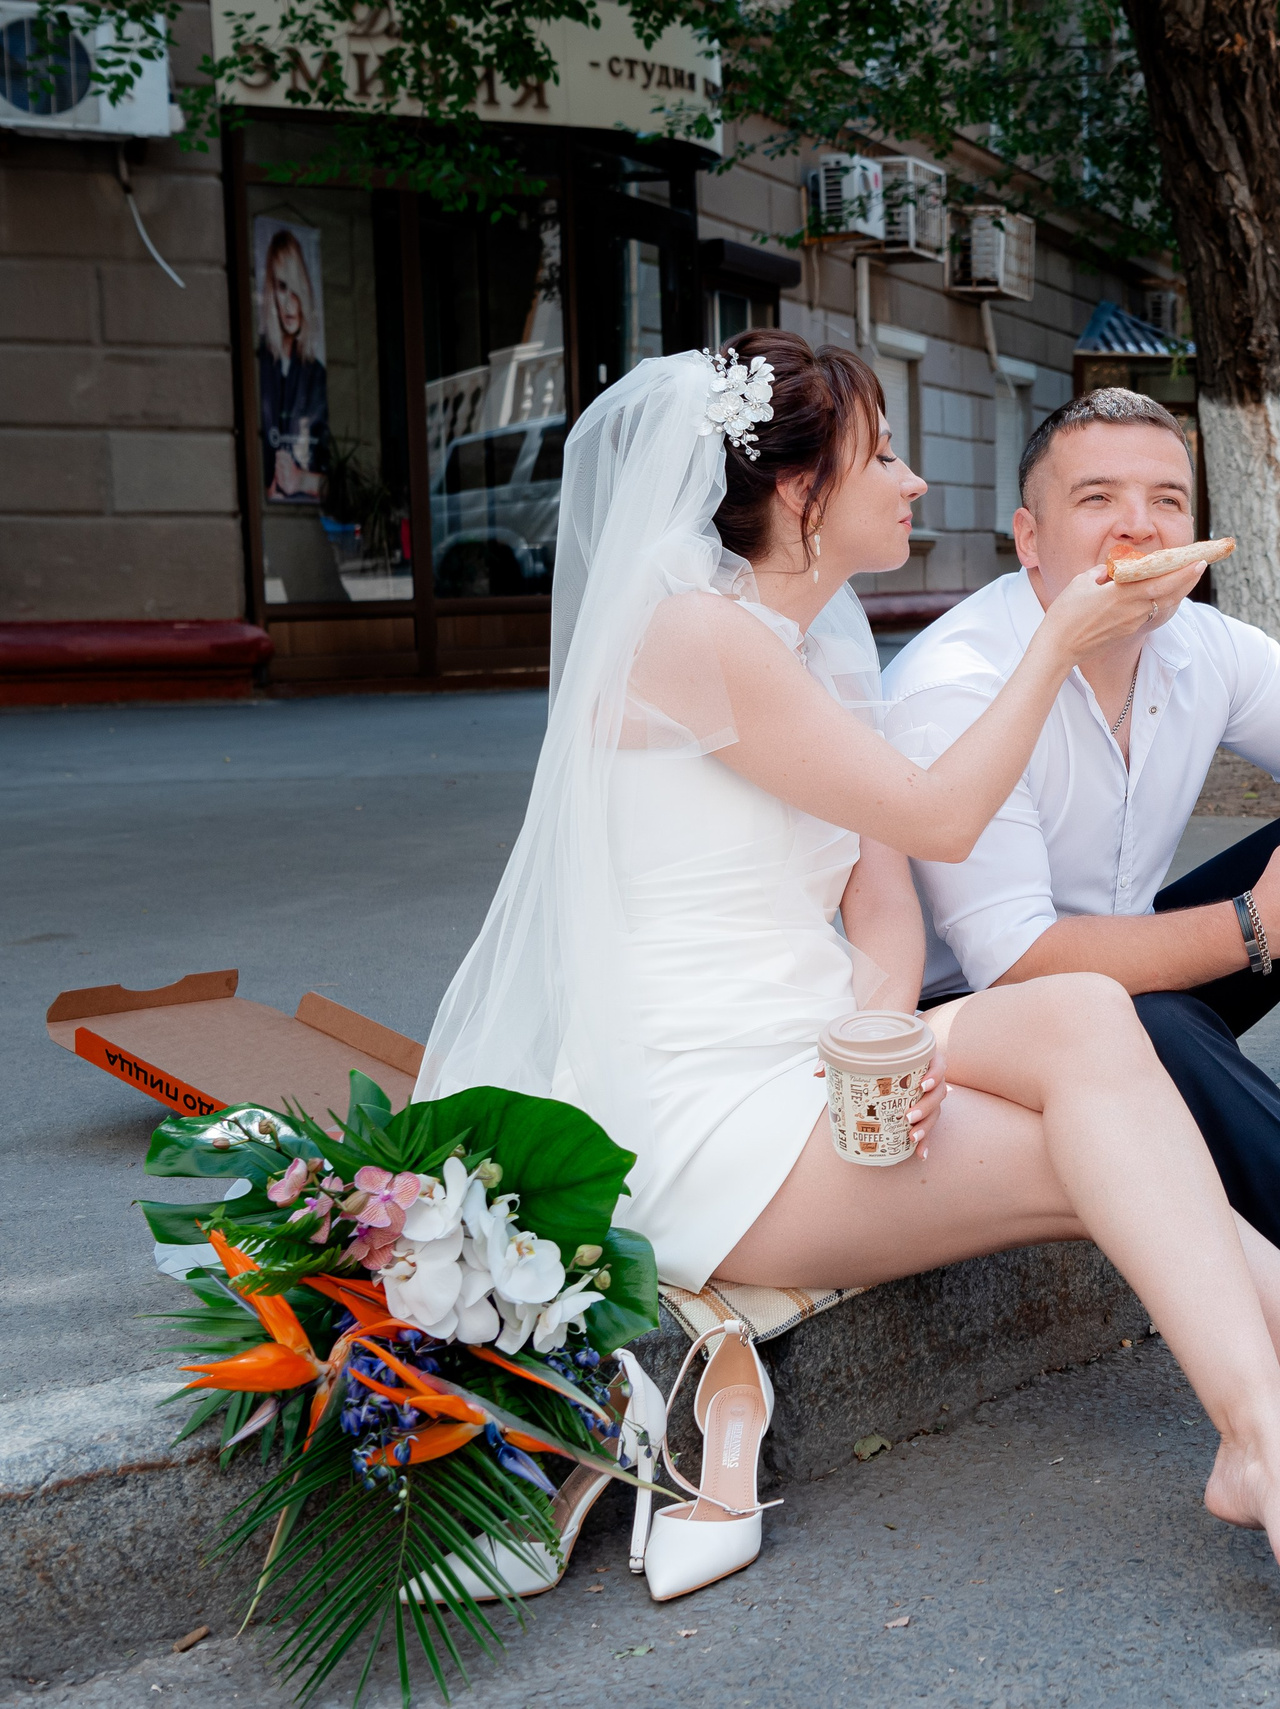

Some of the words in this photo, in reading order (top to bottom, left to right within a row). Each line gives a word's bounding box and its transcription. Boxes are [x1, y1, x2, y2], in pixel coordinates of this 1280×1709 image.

[105, 1048, 179, 1102] ПИЦЦА
[850, 1083, 863, 1102] LIFE
[182, 1094, 219, 1117] ДО
[881, 1097, 908, 1110] START
[838, 1128, 848, 1151] IDEA
[853, 1132, 884, 1142] COFFEE
